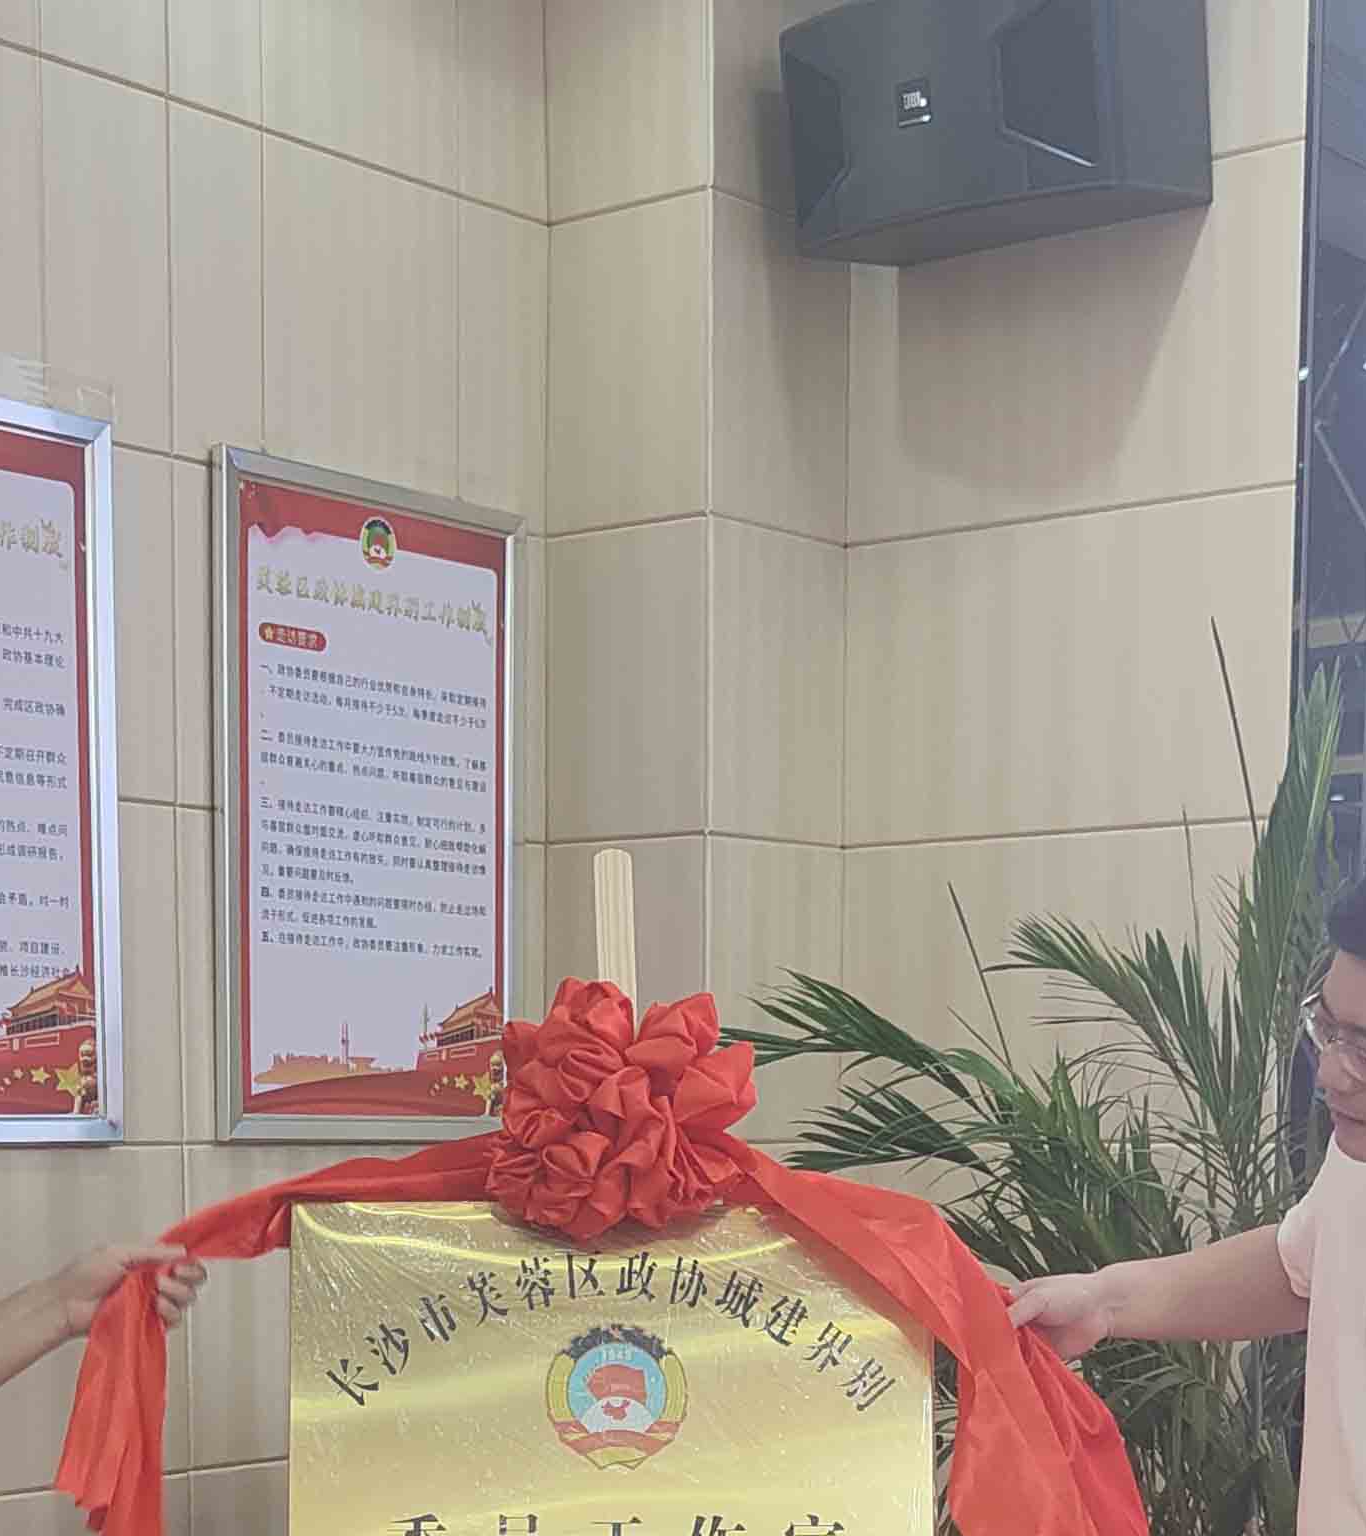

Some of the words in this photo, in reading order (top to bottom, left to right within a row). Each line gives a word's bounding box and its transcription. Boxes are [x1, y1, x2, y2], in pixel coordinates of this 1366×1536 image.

[323, 1249, 898, 1413] 长沙市芙蓉区政协城建界别
